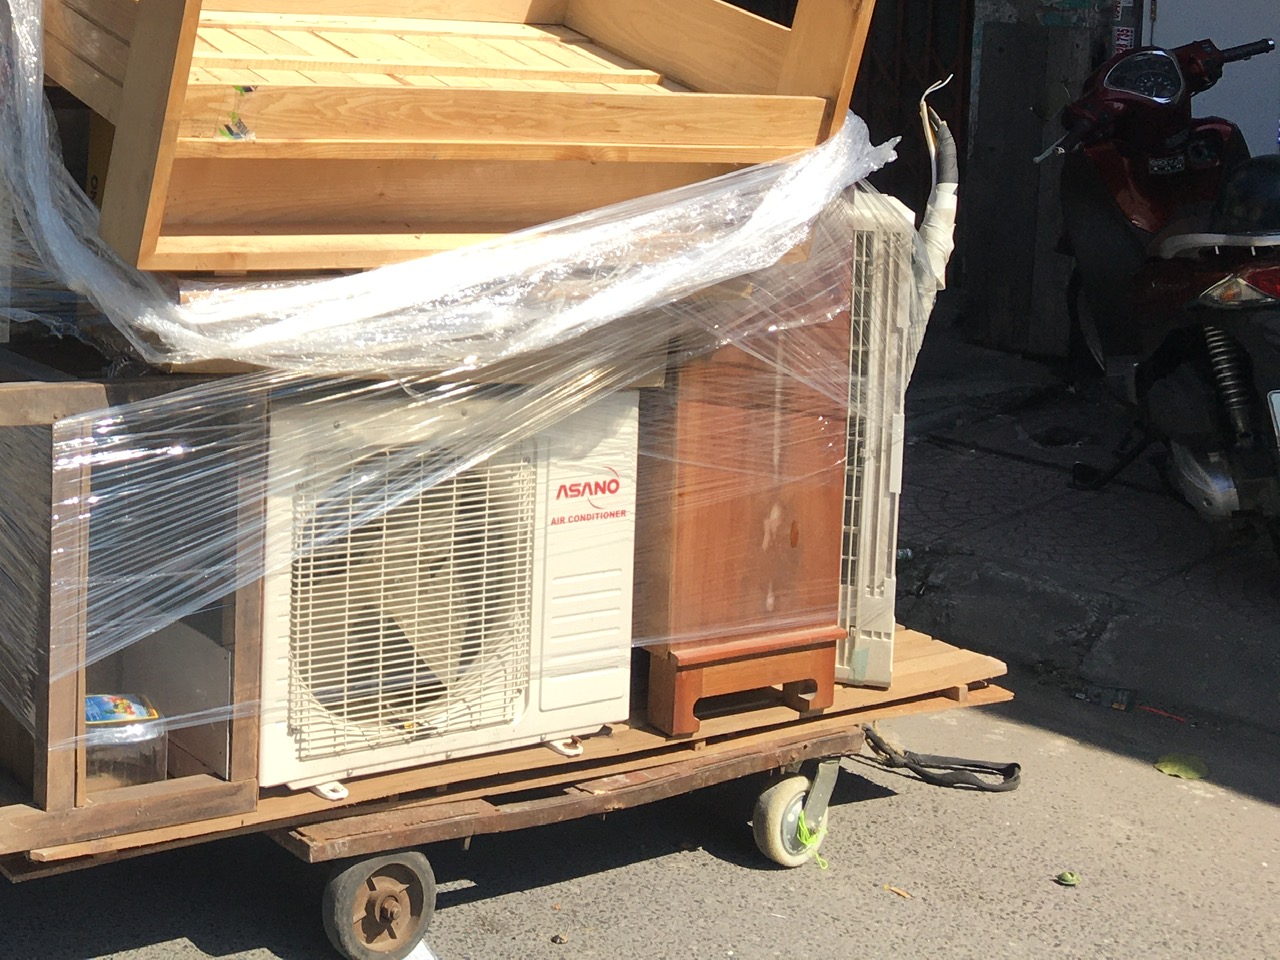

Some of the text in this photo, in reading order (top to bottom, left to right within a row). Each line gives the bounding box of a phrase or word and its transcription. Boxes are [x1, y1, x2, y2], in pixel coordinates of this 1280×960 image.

[556, 478, 620, 500] ASANO
[551, 509, 627, 526] AIR CONDITIONER
